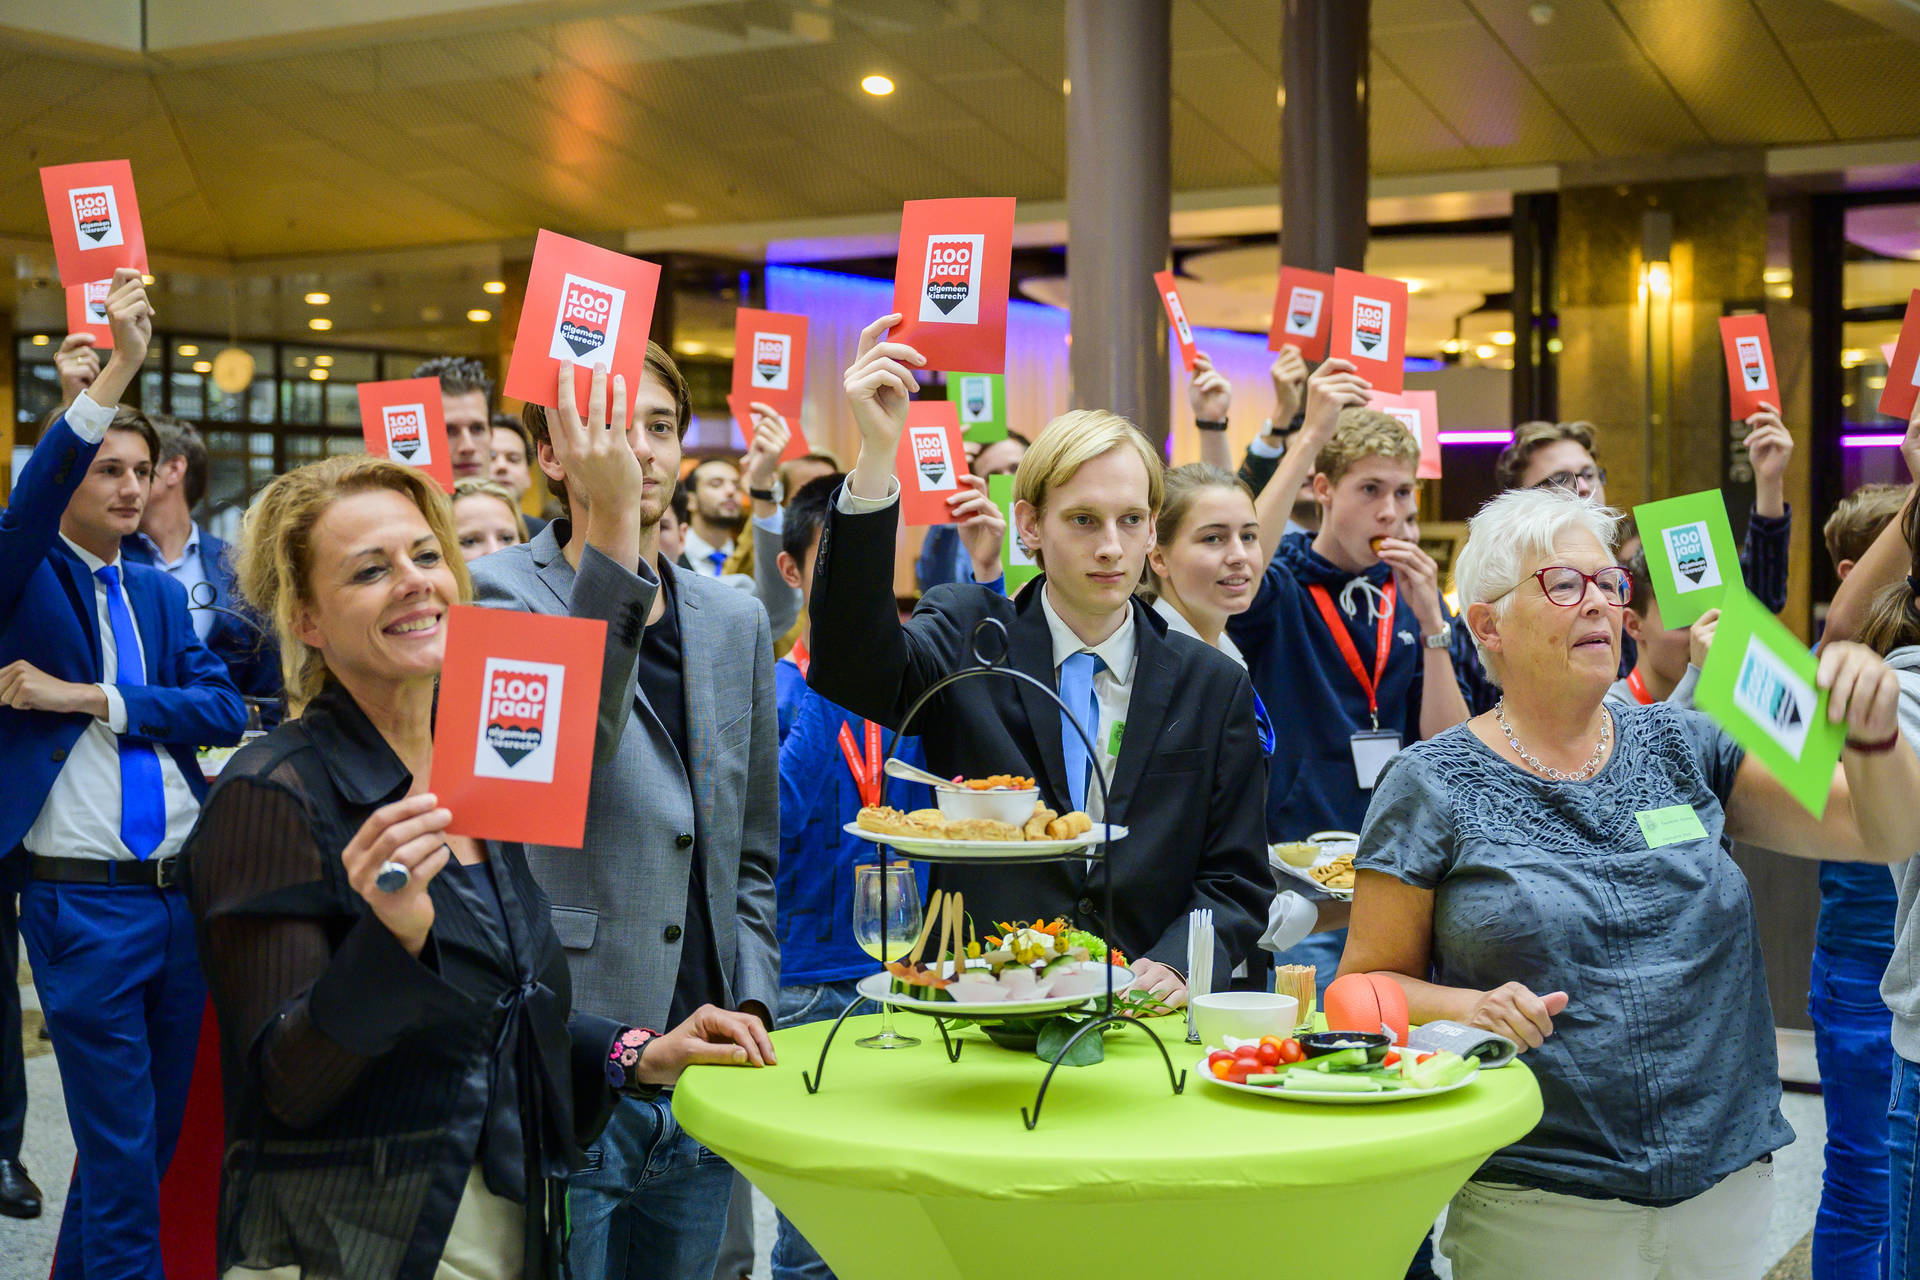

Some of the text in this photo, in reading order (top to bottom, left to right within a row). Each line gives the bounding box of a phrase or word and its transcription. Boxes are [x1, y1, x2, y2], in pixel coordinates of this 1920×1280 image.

[76, 196, 106, 210] 100
[79, 206, 107, 220] jaar
[932, 248, 970, 263] 100
[930, 264, 969, 279] jaar
[928, 284, 967, 293] algemeen
[928, 292, 966, 300] kiesrecht
[568, 289, 609, 313] 100
[565, 304, 607, 325] jaar
[1357, 306, 1382, 320] 100
[562, 330, 602, 347] kiesrecht
[563, 324, 603, 341] algemeen
[390, 414, 417, 427] 100
[391, 425, 418, 439] jaar
[916, 437, 941, 448] 100
[919, 448, 942, 460] jaar
[1672, 530, 1699, 546] 100
[1675, 543, 1701, 559] jaar
[492, 678, 545, 702] 100
[489, 699, 544, 720] jaar
